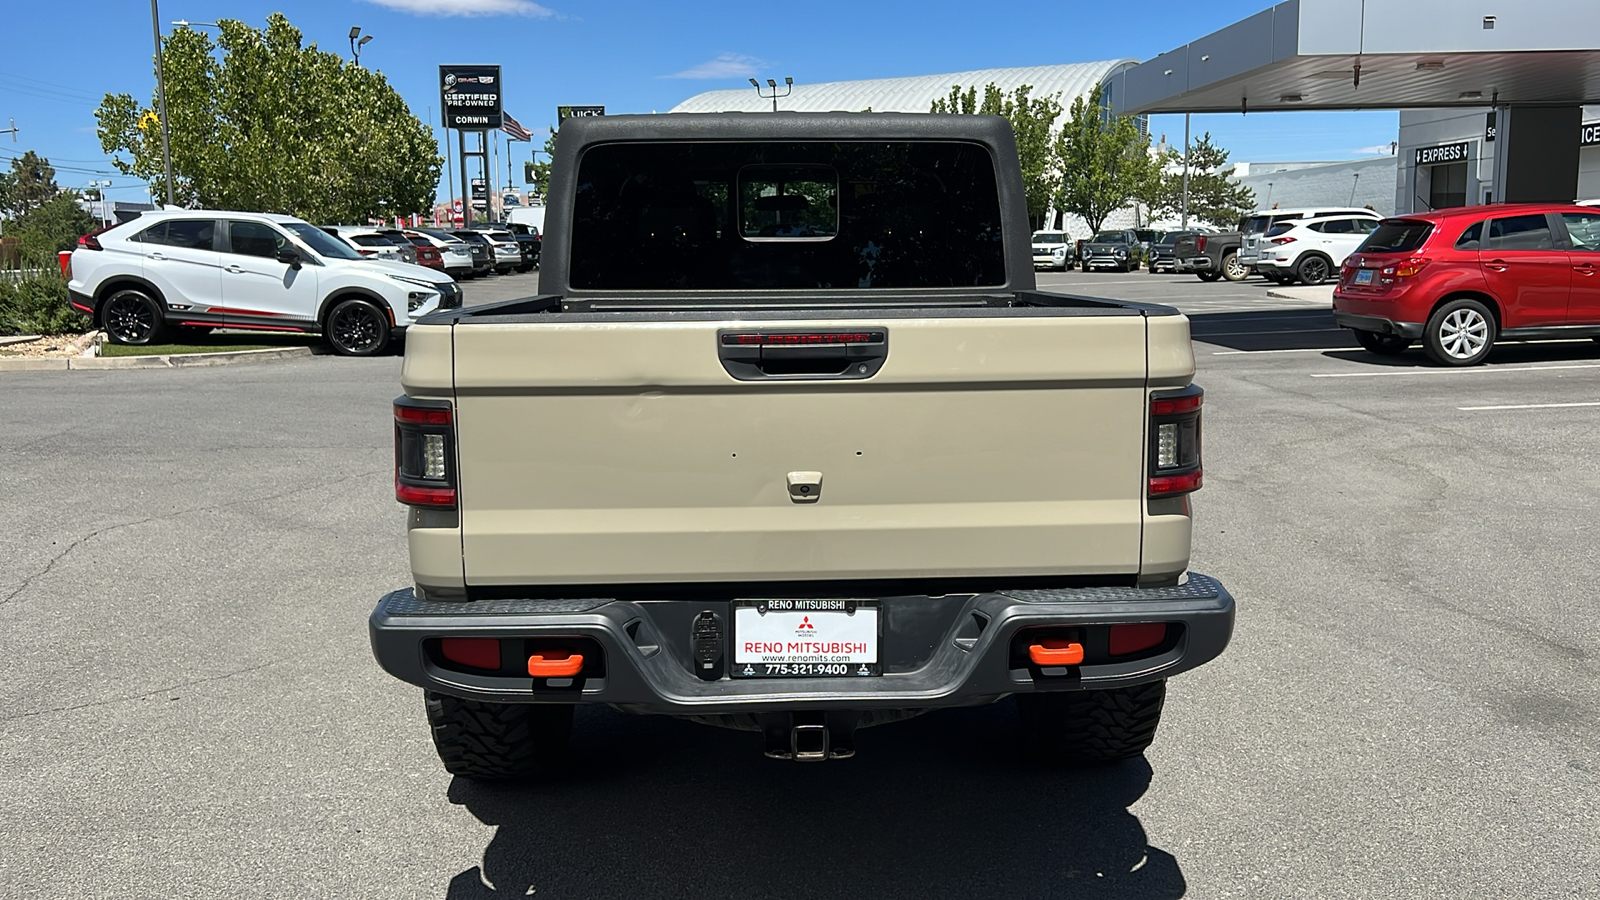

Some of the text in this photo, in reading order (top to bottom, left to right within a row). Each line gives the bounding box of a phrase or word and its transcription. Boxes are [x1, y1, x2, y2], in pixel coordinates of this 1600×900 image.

[444, 93, 497, 101] CERTIFIED
[455, 116, 489, 124] CORWIN
[1422, 147, 1461, 163] EXPRESS
[768, 600, 846, 610] RENO MITSUBISHI
[744, 642, 867, 654] RENO MITSUBISHI
[761, 654, 851, 662] www.renomits.com
[765, 664, 848, 675] 775-321-9400
